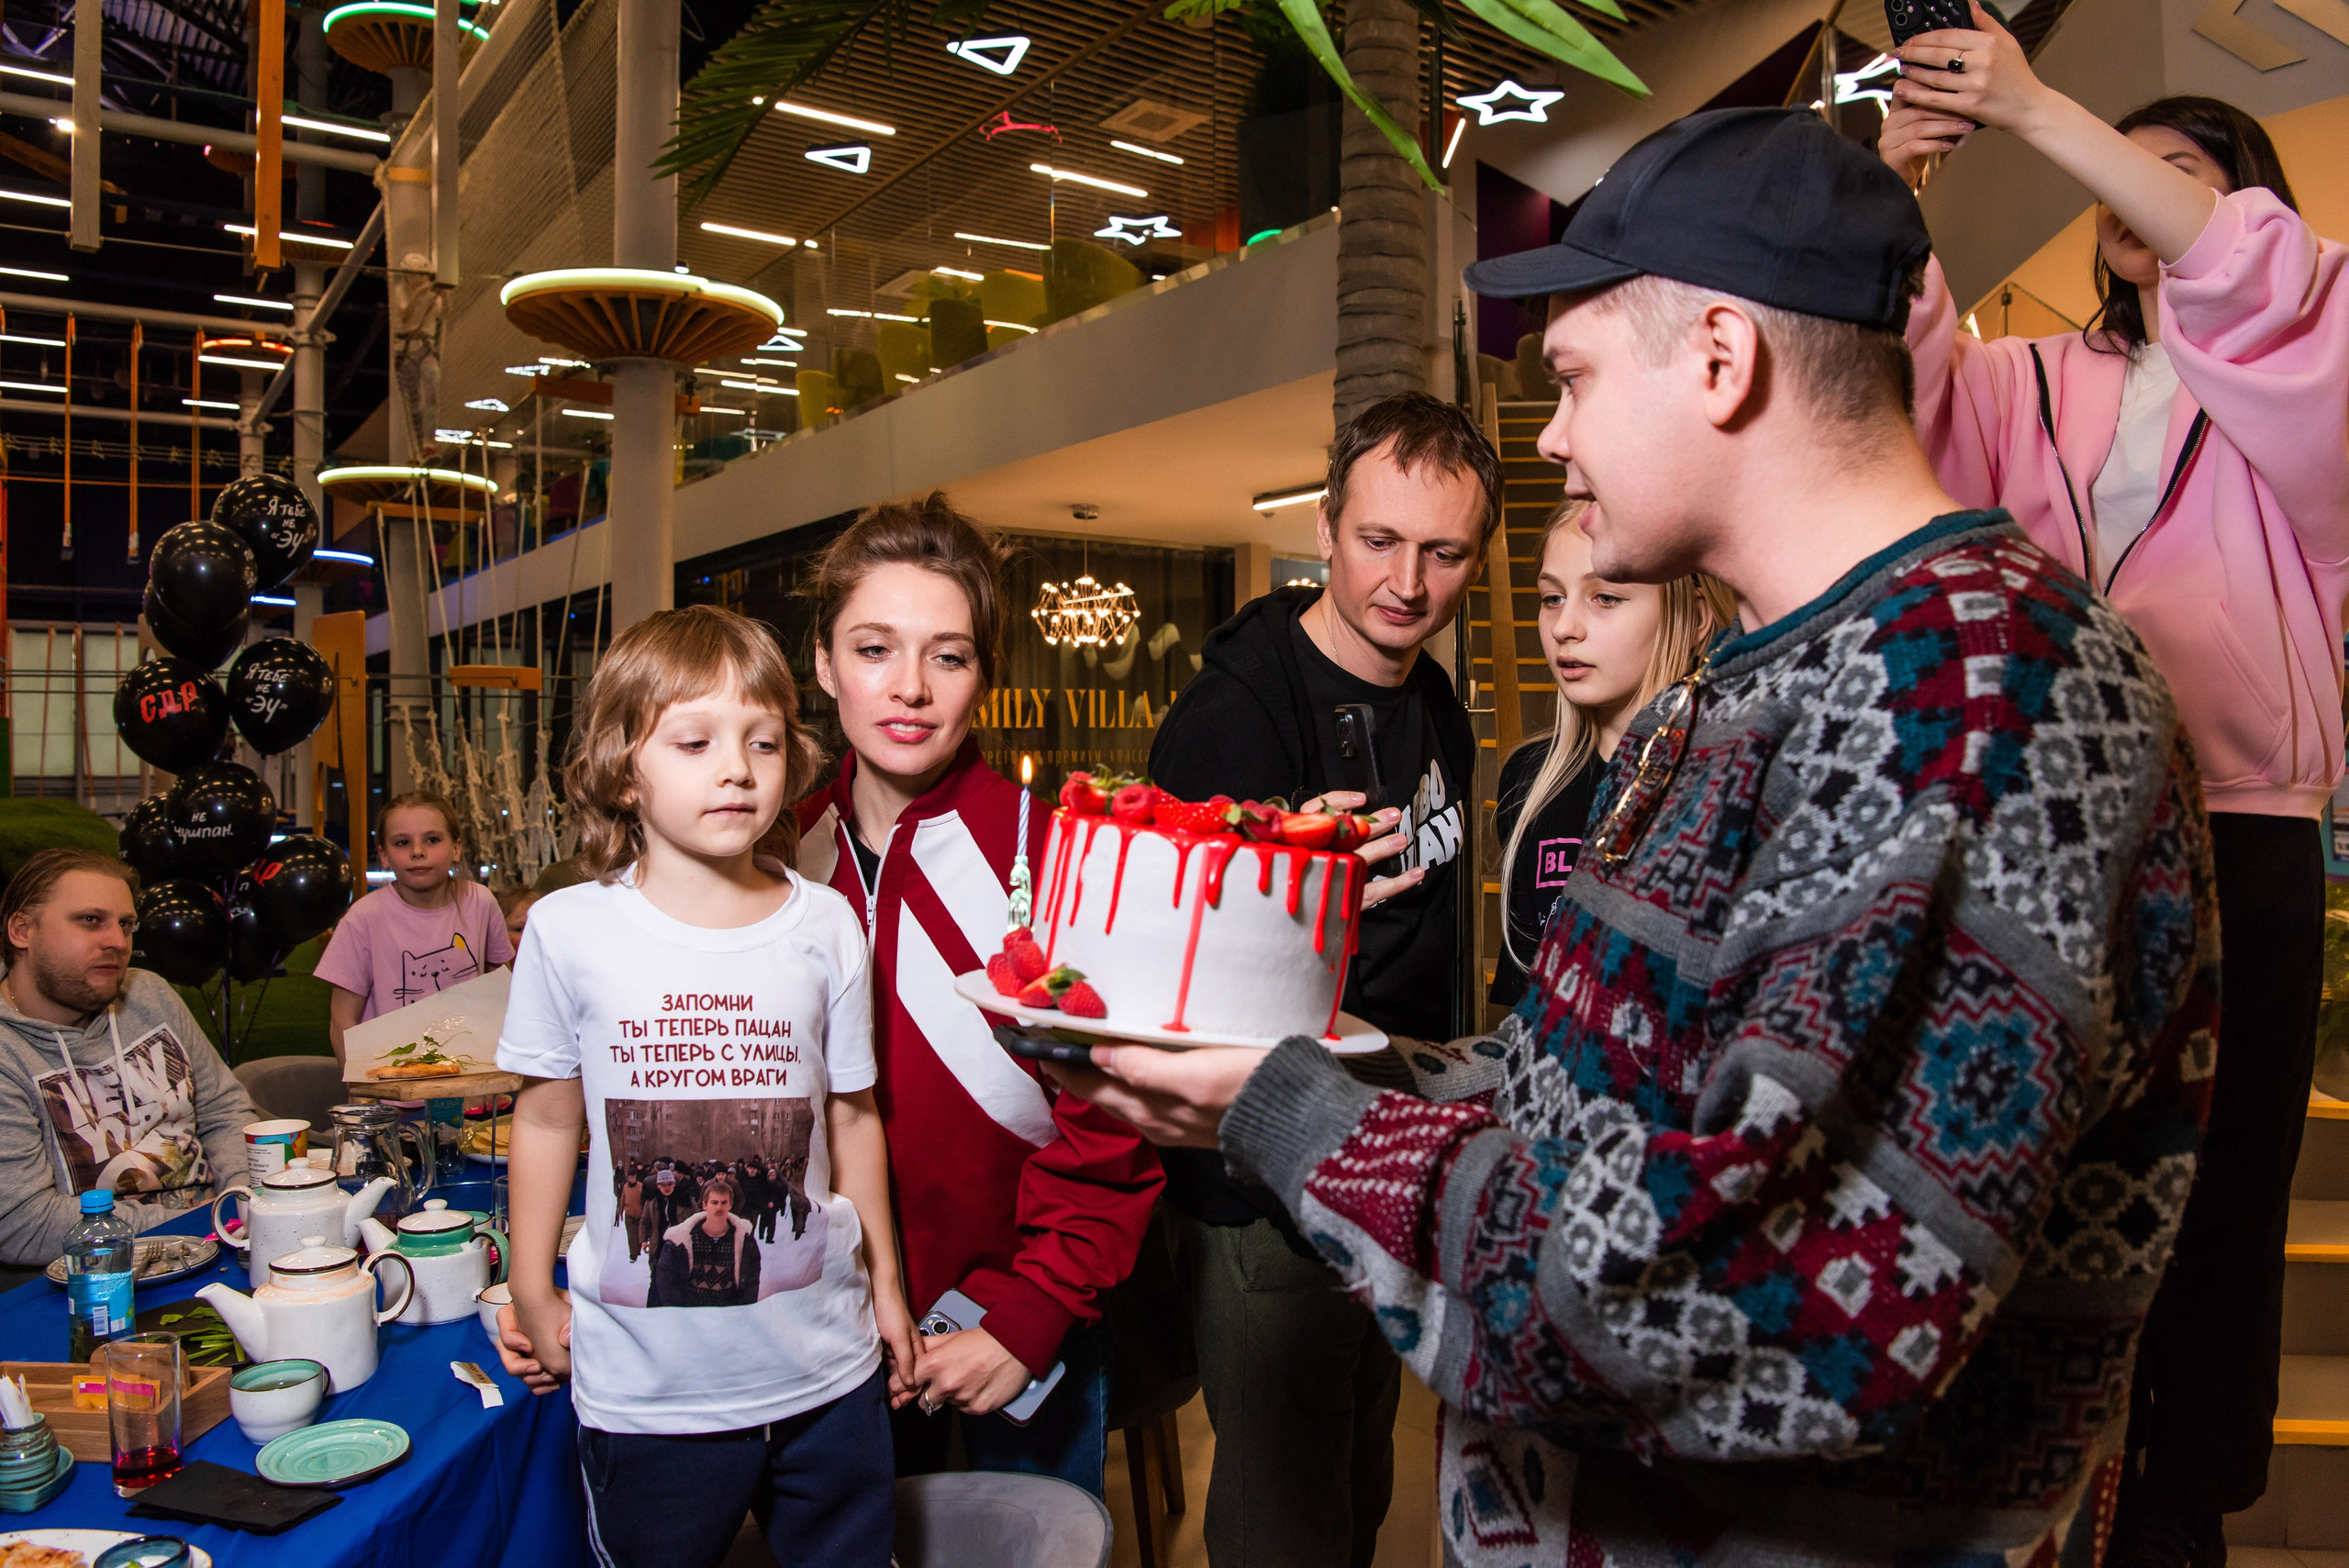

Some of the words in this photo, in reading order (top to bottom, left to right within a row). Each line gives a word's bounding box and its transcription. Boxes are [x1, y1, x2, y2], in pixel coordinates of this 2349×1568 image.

[267, 496, 278, 515] Я
[244, 662, 260, 679] Я
[258, 669, 289, 683] ТЕБЕ
[140, 681, 197, 724] СДР
[1064, 688, 1154, 728] VILLA
[661, 994, 753, 1012] ЗАПОМНИ
[618, 1020, 648, 1039] ТЫ
[654, 1018, 729, 1037] ТЕПЕРЬ
[735, 1018, 791, 1039] ПАЦАН
[609, 1045, 635, 1063] ТЫ
[640, 1043, 716, 1062] ТЕПЕРЬ
[721, 1043, 734, 1062] С
[740, 1043, 801, 1064] УЛИЦЫ,
[630, 1070, 640, 1088] А
[645, 1068, 726, 1088] КРУГОМ
[731, 1068, 786, 1086] ВРАГИ
